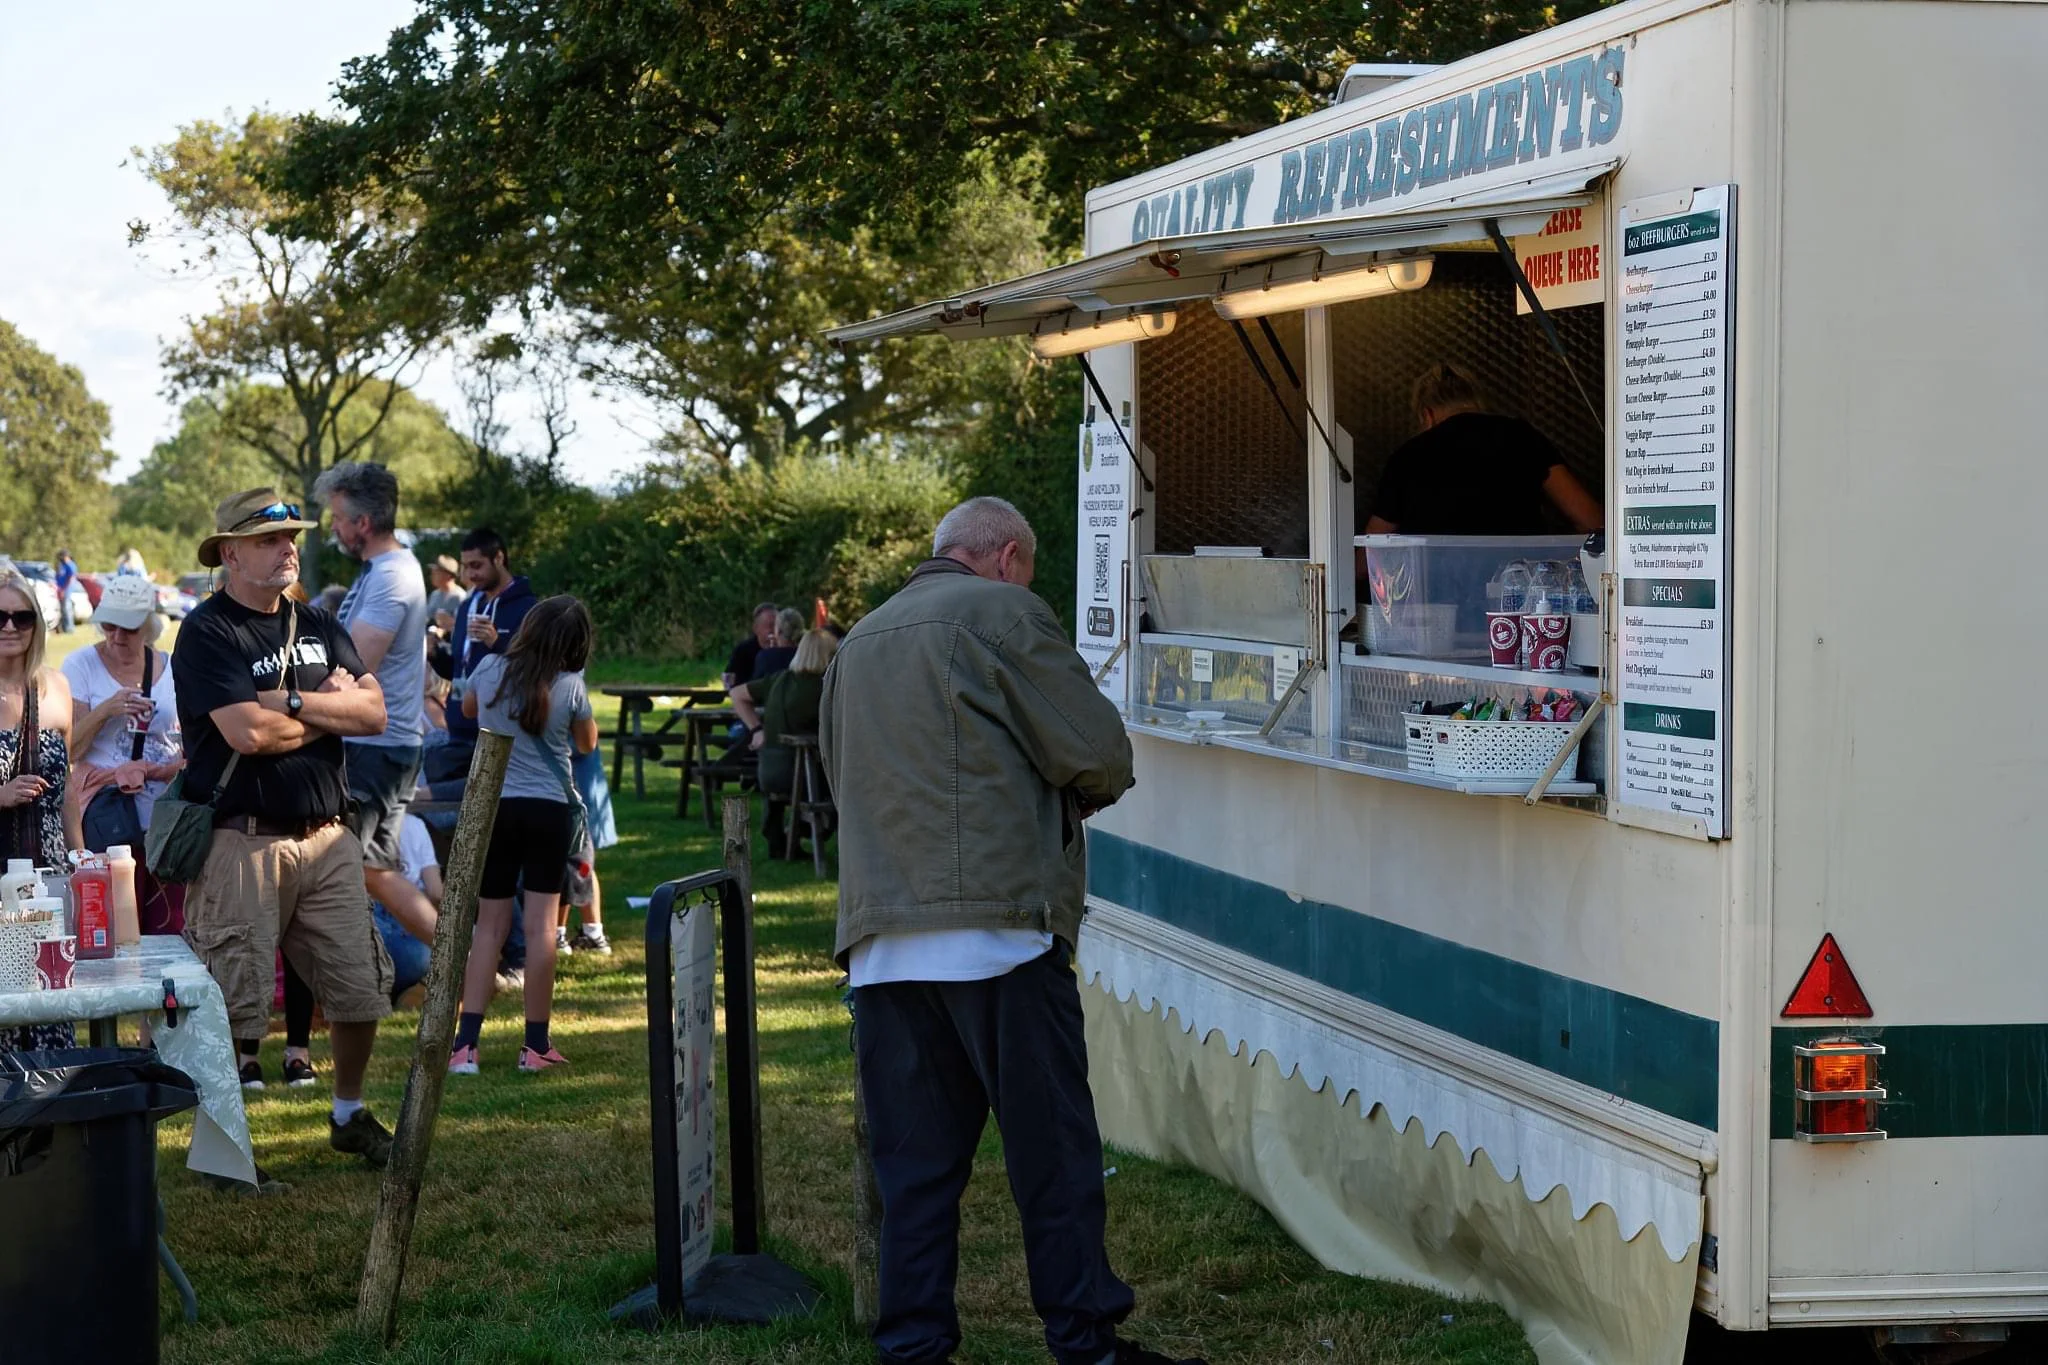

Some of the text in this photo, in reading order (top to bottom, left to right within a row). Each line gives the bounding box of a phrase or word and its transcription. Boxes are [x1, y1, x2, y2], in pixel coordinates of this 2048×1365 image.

[1132, 45, 1625, 243] QUALITY REFRESHMENTS
[1538, 208, 1582, 236] LEASE
[1628, 234, 1640, 249] 6oz
[1641, 223, 1690, 246] BEEFBURGERS
[1524, 244, 1600, 288] QUEUE HERE
[1626, 284, 1653, 295] Cheeseburger
[1626, 304, 1638, 313] Bacon
[1639, 302, 1653, 313] Burger
[1634, 320, 1647, 332] Burger
[1626, 338, 1644, 350] Pineapple
[1646, 337, 1659, 349] Burger
[1626, 376, 1639, 385] Cheese
[1640, 373, 1662, 385] Beefburger
[1663, 370, 1682, 381] (Double)
[1639, 392, 1652, 402] Cheese
[1654, 392, 1667, 404] Burger
[1626, 411, 1641, 422] Chicken
[1642, 411, 1655, 423] Burger
[1626, 430, 1638, 442] Veggie
[1639, 429, 1652, 441] Burger
[1638, 448, 1646, 460] Bap
[1634, 466, 1642, 478] Dog
[1648, 464, 1660, 475] french
[1661, 463, 1673, 474] bread
[1643, 483, 1656, 493] french
[1656, 482, 1668, 493] bread
[1627, 516, 1650, 530] EXTRAS
[1651, 520, 1665, 530] served
[1665, 519, 1675, 529] with
[1675, 522, 1684, 532] any
[1685, 519, 1690, 530] of
[1699, 519, 1712, 529] above
[1651, 544, 1672, 552] Mushrooms
[1677, 542, 1696, 554] pineapple
[1666, 559, 1676, 568] Extra
[1676, 560, 1690, 570] Sausage
[1652, 586, 1683, 601] SPECIALS
[1626, 616, 1643, 626] Breakfast
[1634, 664, 1642, 676] Dog
[1643, 665, 1658, 677] Special
[1655, 713, 1681, 729] DRINKS
[1626, 753, 1636, 761] Coffee
[1633, 768, 1648, 777] Chocolate
